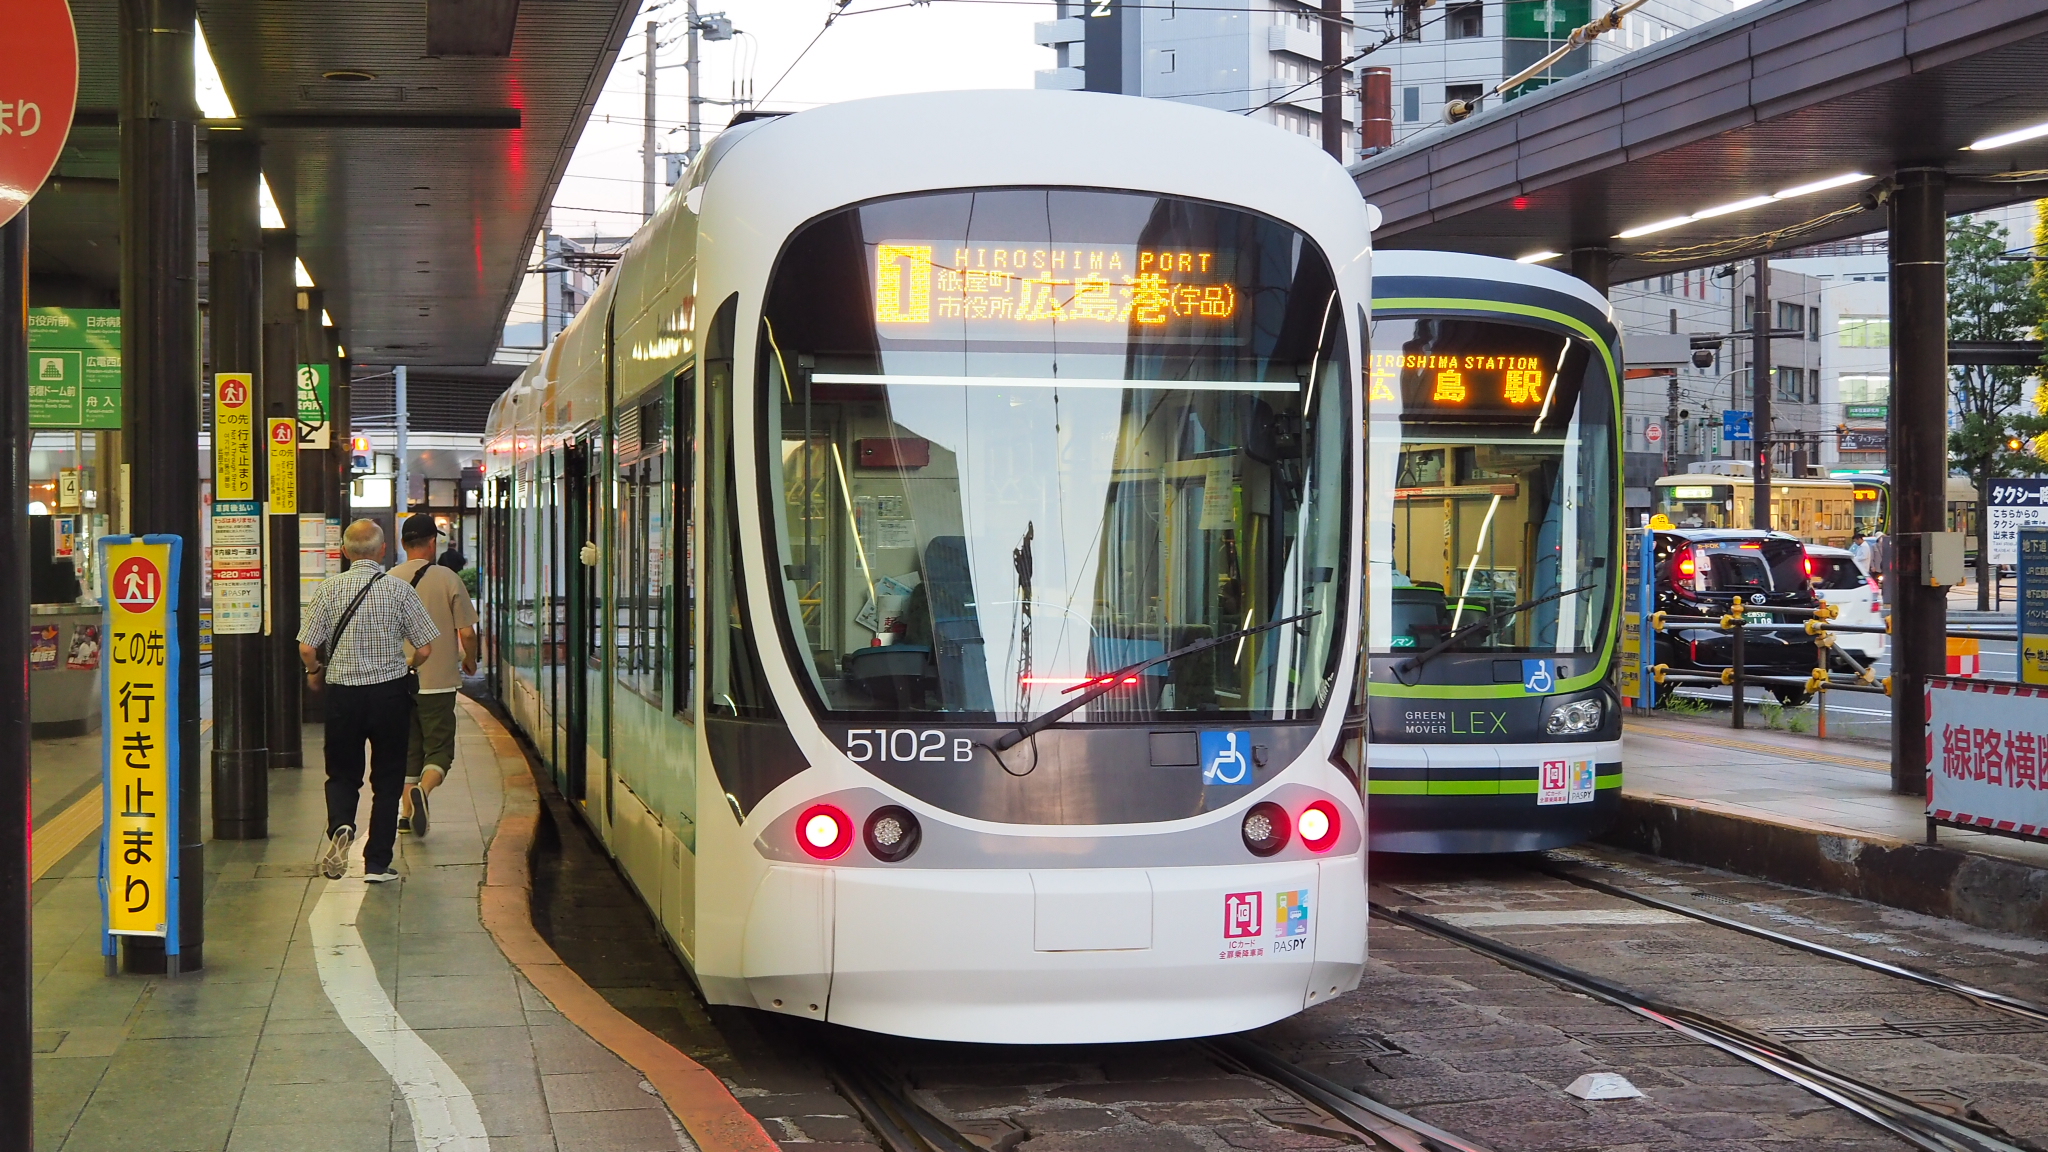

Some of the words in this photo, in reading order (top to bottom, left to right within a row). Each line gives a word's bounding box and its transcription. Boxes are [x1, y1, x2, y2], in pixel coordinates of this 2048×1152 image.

[955, 248, 1122, 271] HIROSHIMA
[1140, 252, 1213, 272] PORT
[937, 269, 1014, 293] 紙屋町
[937, 296, 1014, 319] 市役所
[1464, 356, 1538, 370] STATION
[218, 414, 249, 425] この先
[238, 429, 249, 492] 行き止まり
[271, 449, 294, 457] この先
[66, 480, 75, 494] 4
[286, 460, 294, 509] 行き止まり
[1993, 510, 2039, 519] こちらからの
[1992, 531, 2019, 540] 出来ま
[113, 630, 164, 667] この先
[1405, 711, 1446, 720] GREEN
[1405, 725, 1447, 734] MOVER
[1451, 711, 1508, 734] LEX
[846, 729, 946, 762] 5102
[953, 738, 973, 762] B
[118, 681, 156, 914] 行き止まり
[1571, 790, 1592, 800] PASPY
[1228, 939, 1256, 949] ICカード
[1273, 937, 1307, 954] PASPY
